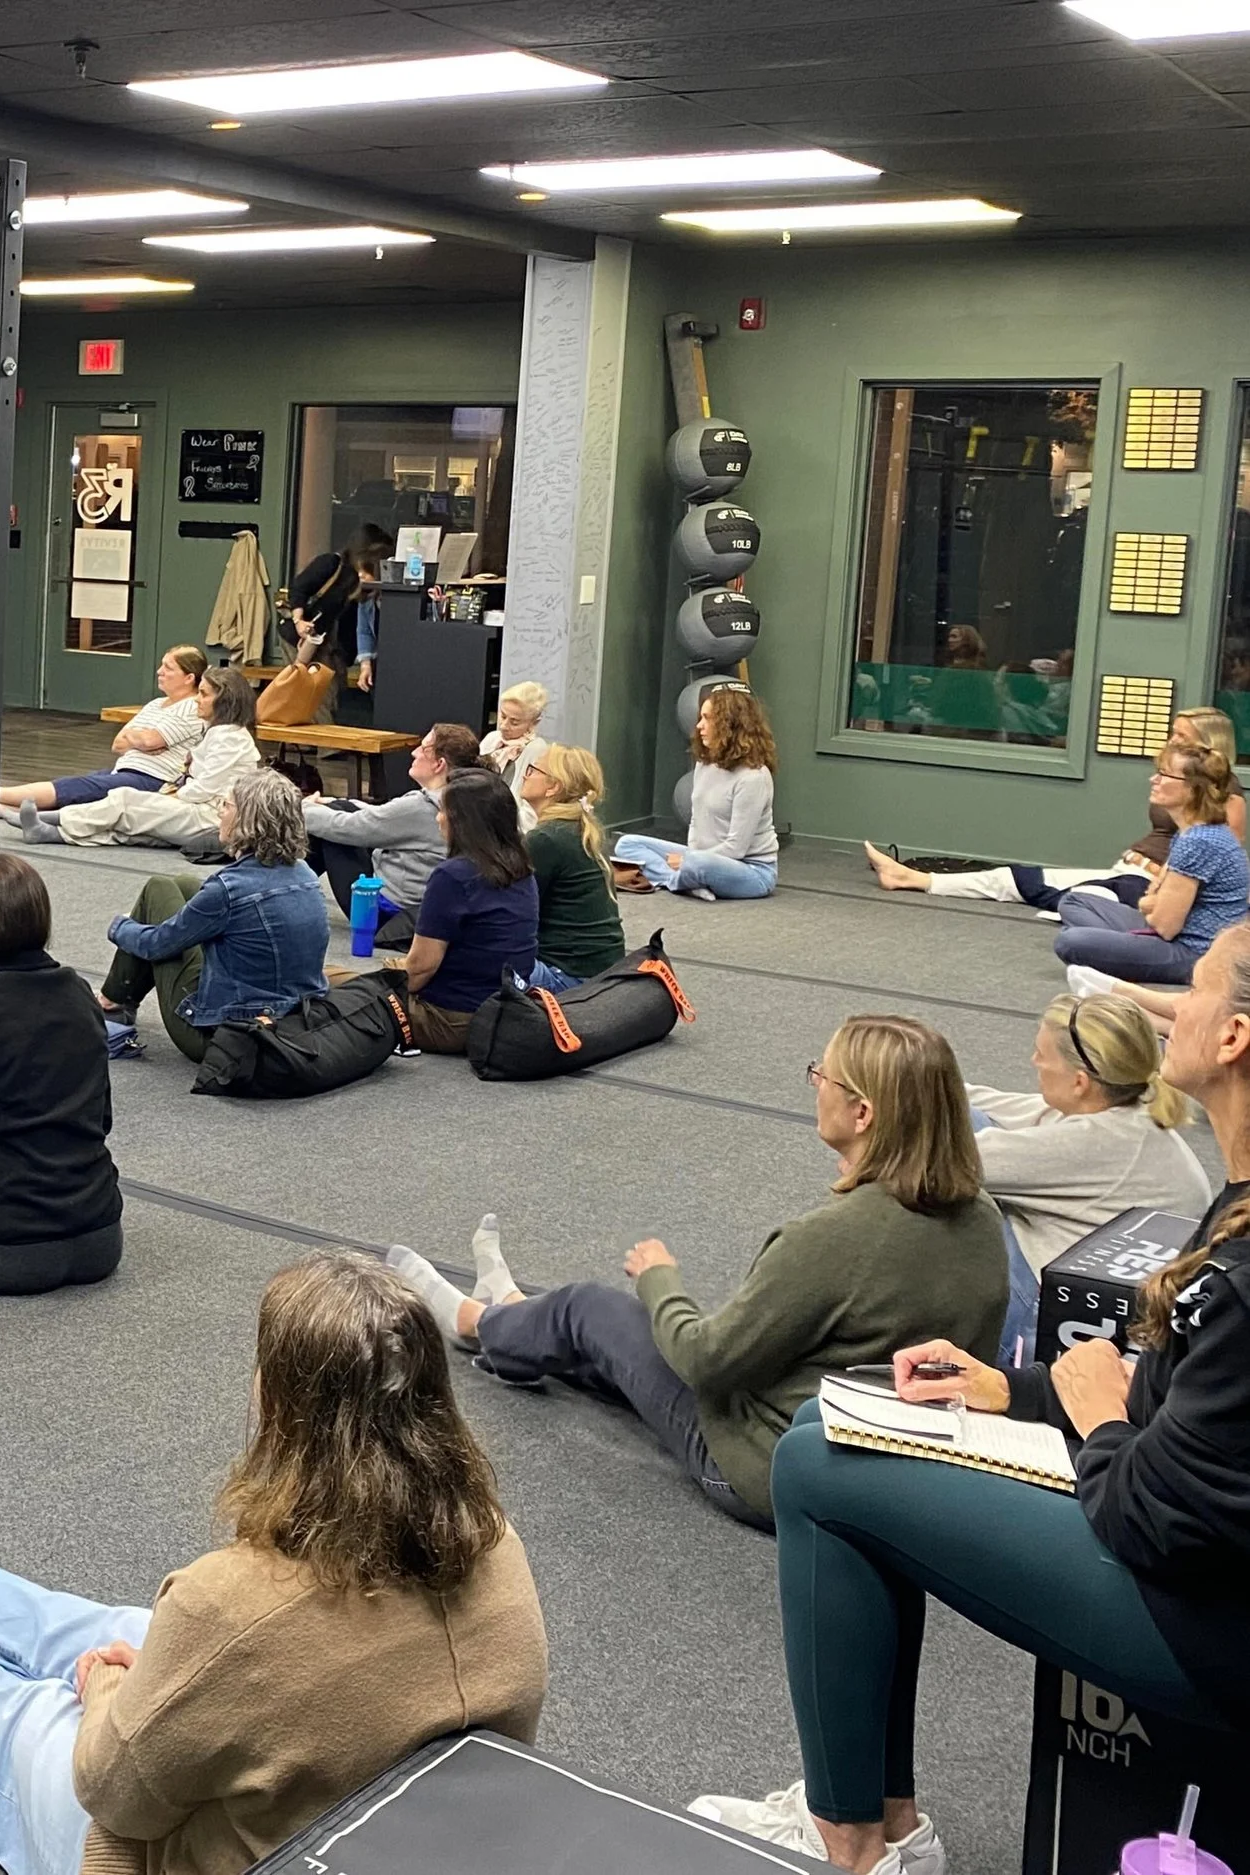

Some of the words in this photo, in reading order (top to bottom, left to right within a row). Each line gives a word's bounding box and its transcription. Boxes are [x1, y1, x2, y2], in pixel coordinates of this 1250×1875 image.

[85, 344, 116, 370] EXIT
[190, 434, 220, 447] Wear
[726, 462, 741, 472] 8LB
[732, 540, 751, 549] 10LB
[731, 622, 751, 631] 12LB
